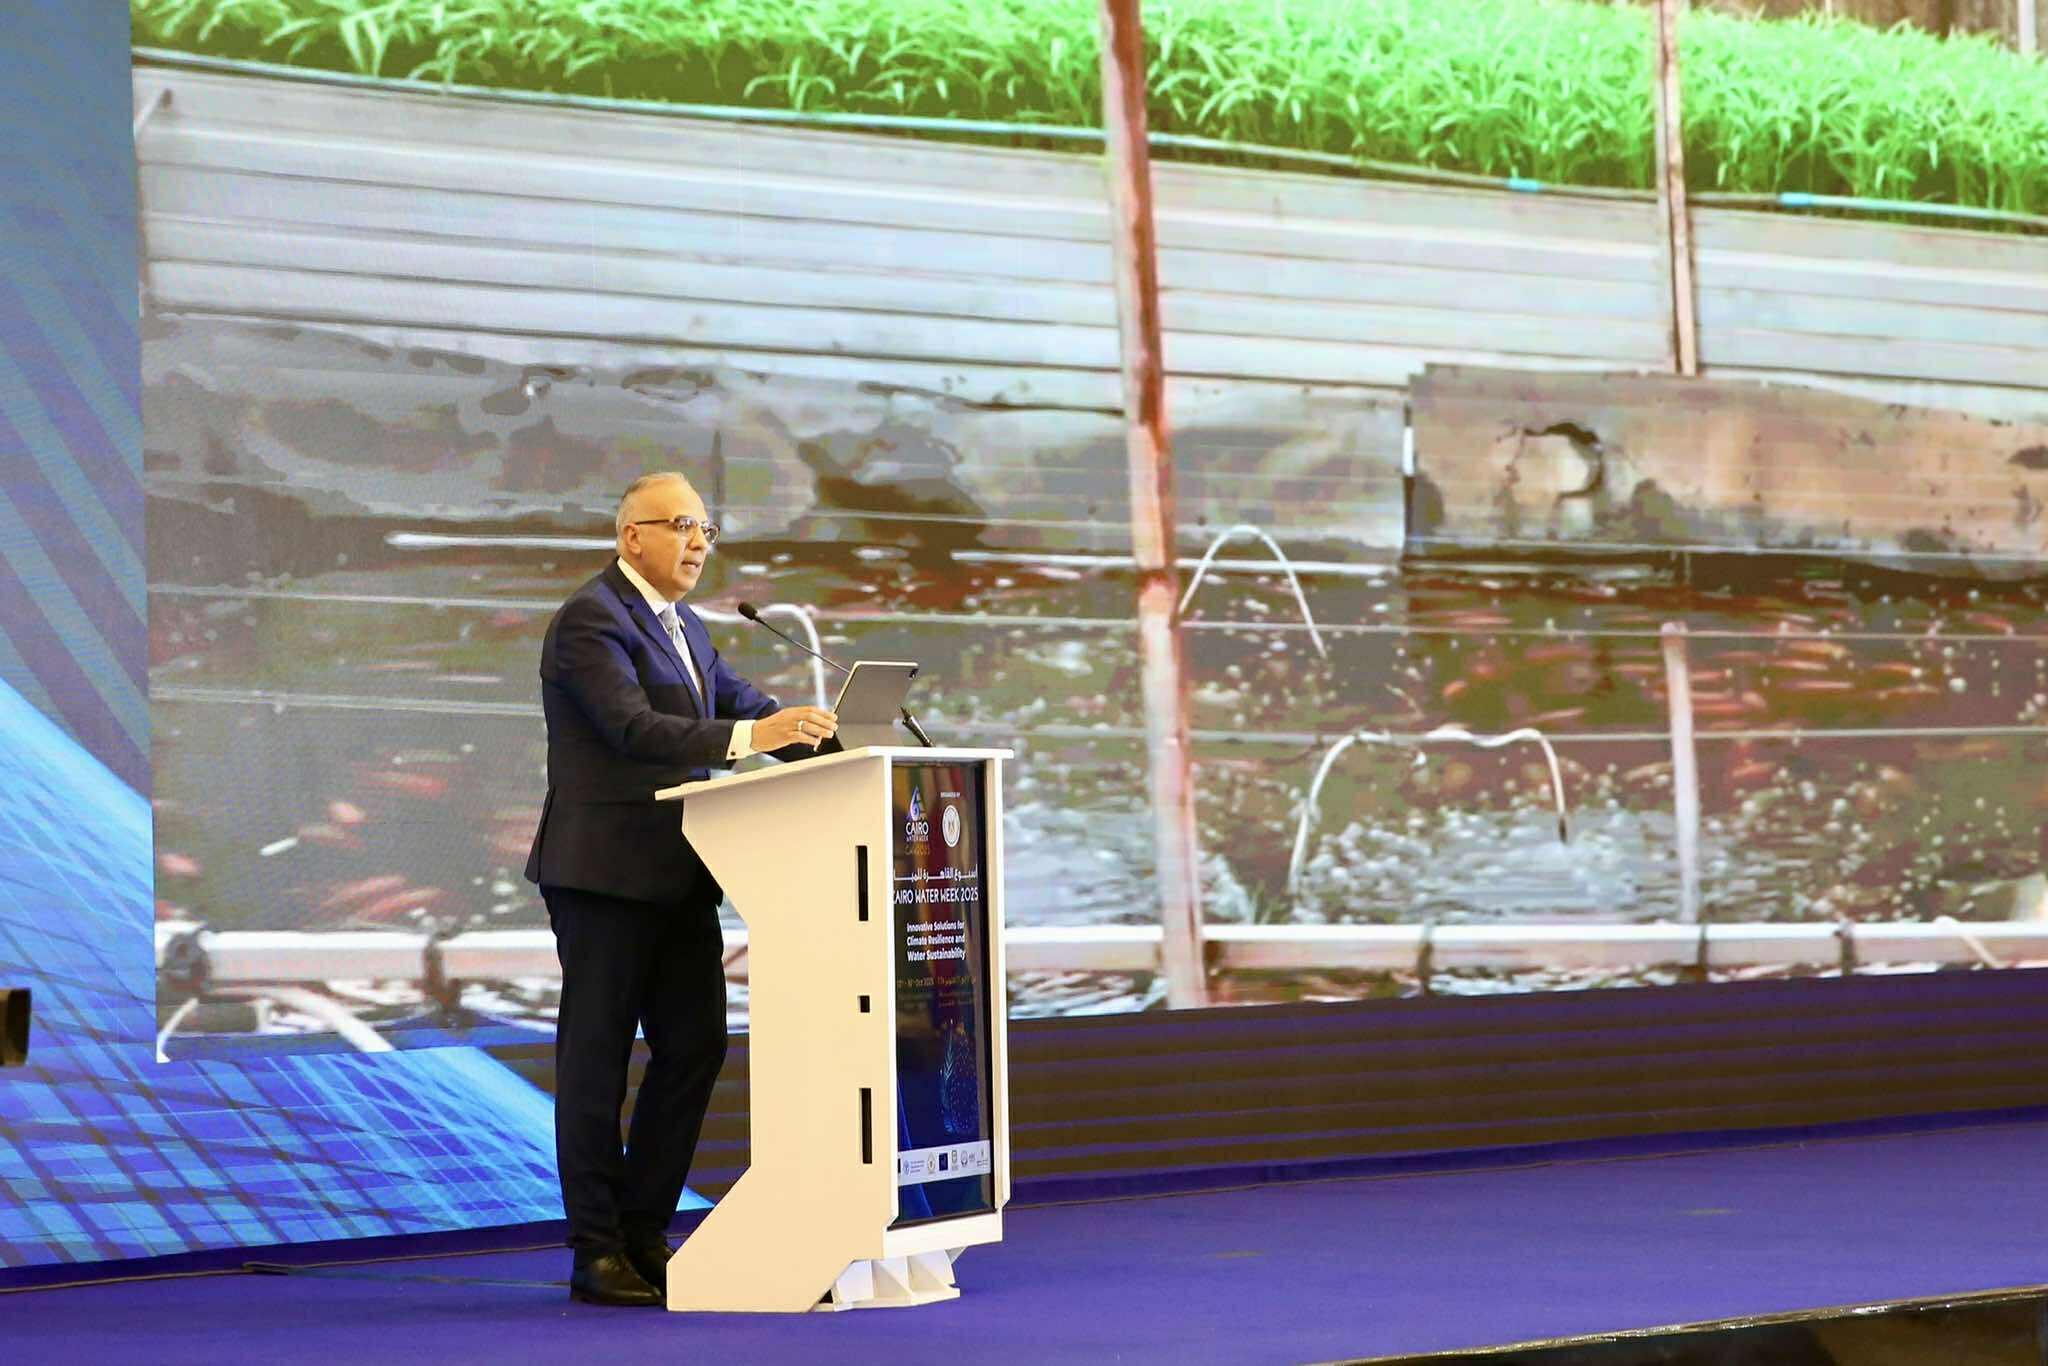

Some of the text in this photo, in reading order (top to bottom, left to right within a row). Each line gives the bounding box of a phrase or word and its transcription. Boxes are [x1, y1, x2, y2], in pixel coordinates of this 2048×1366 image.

[905, 821, 929, 835] CAIRO
[915, 888, 939, 903] WATER
[940, 887, 960, 902] WEEK
[961, 886, 979, 901] 2025
[906, 920, 965, 932] Innovative Solutions for
[906, 932, 965, 946] Climate Resilience and
[907, 947, 966, 962] Water Sustainability
